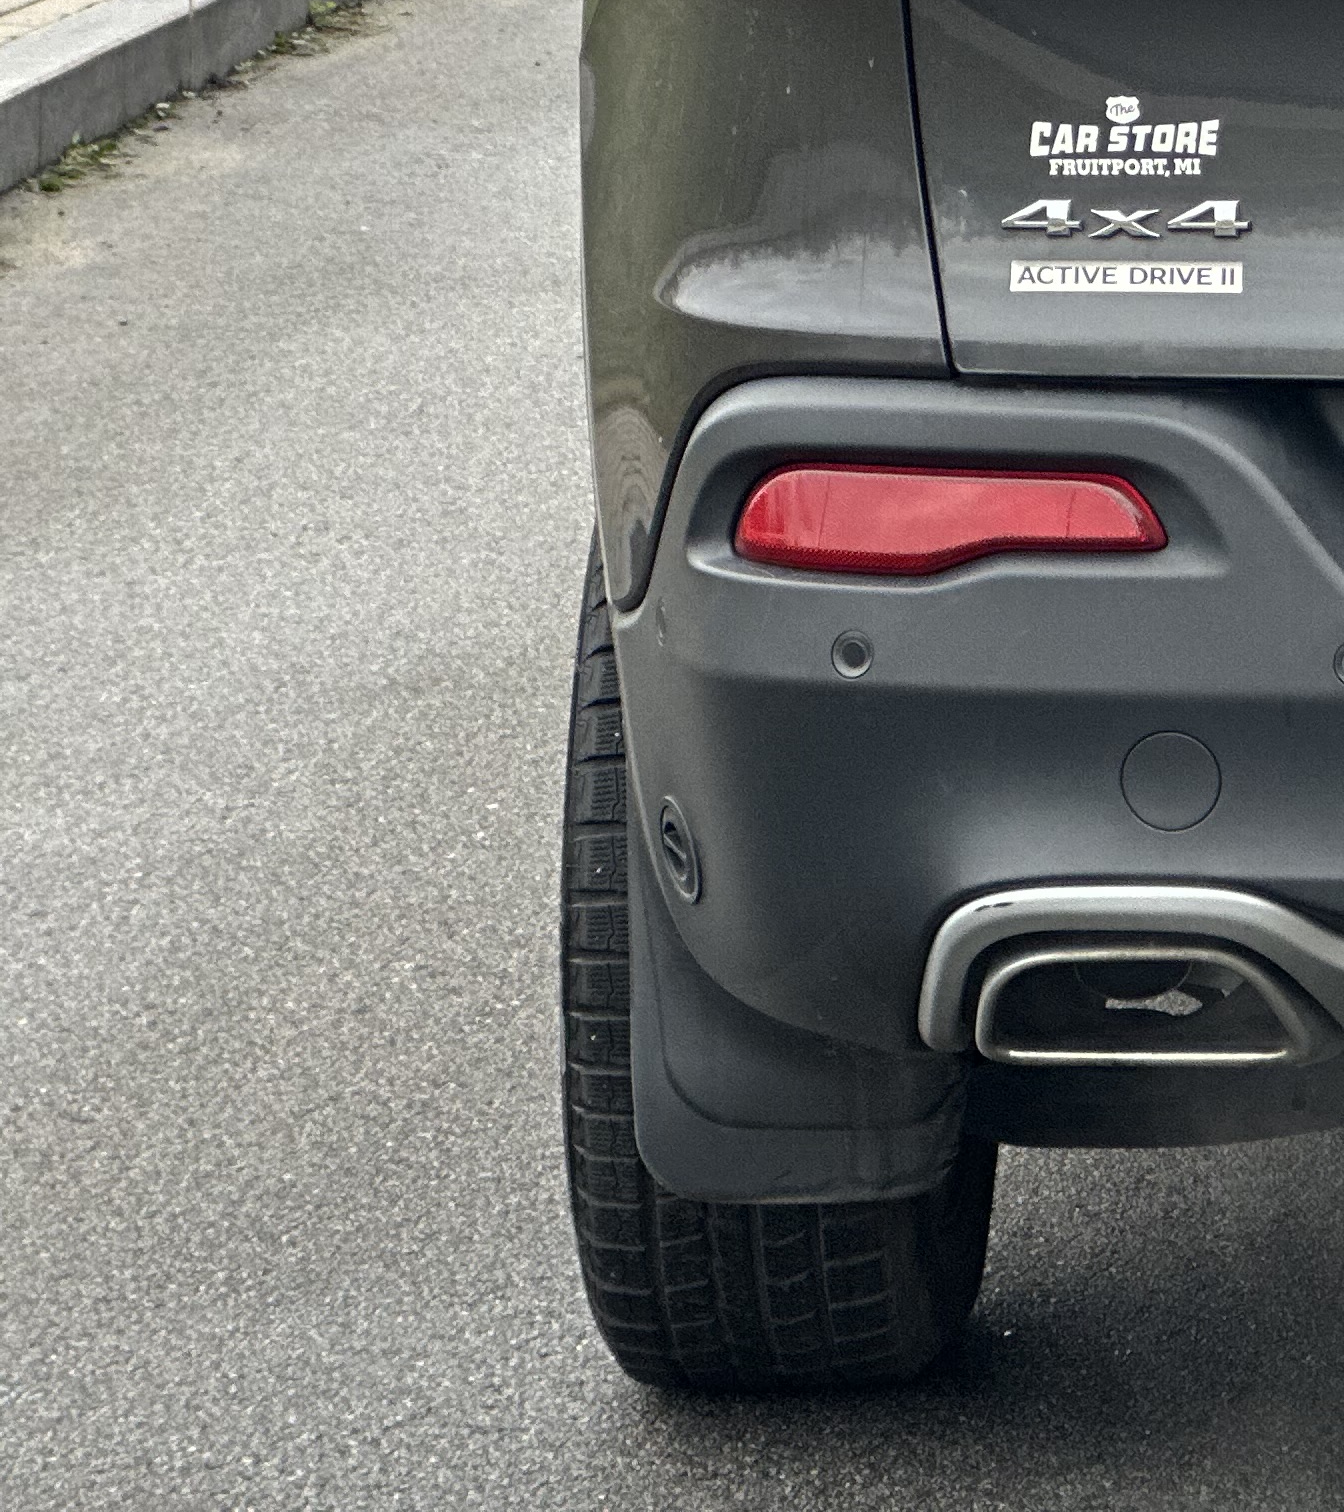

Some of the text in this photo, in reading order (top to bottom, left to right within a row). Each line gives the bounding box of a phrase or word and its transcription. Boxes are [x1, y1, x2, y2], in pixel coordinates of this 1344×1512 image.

[1109, 102, 1136, 117] The
[1029, 119, 1220, 157] CAR STORE
[1049, 158, 1201, 177] FRUITPORT, MI
[1017, 265, 1235, 287] ACTIVE DRIVE II
